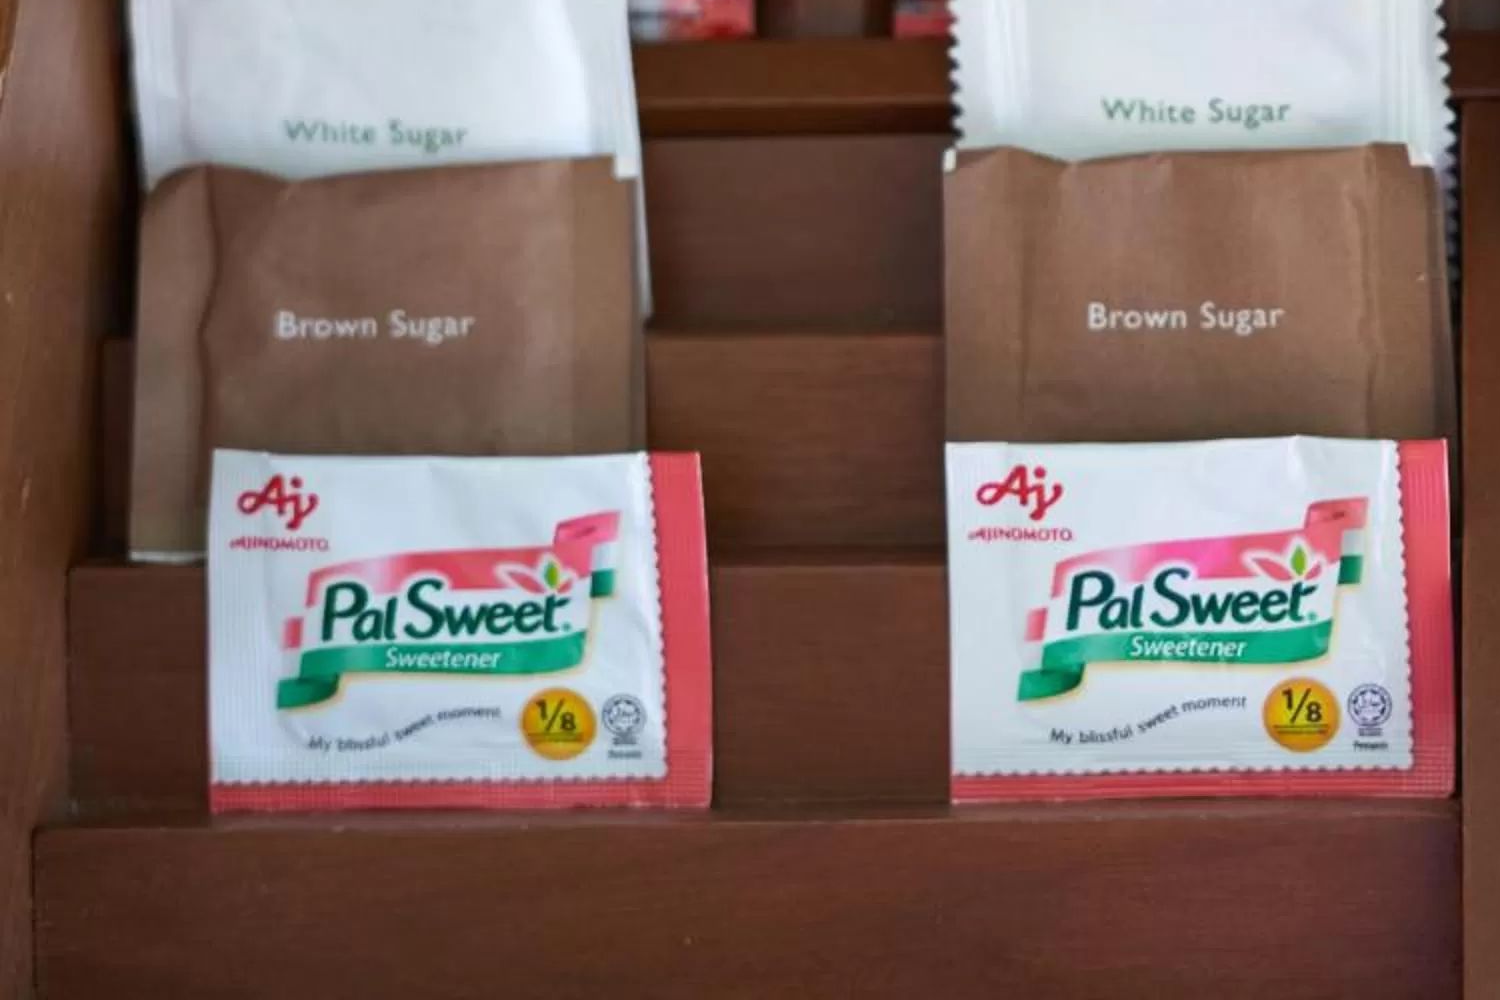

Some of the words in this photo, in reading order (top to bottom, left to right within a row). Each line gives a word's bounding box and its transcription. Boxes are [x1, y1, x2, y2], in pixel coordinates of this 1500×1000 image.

[1101, 97, 1196, 124] White
[1209, 99, 1291, 132] Sugar
[283, 119, 375, 145] White
[389, 119, 468, 153] Sugar
[274, 311, 377, 339] Brown
[390, 309, 475, 345] Sugar
[1087, 303, 1187, 331] Brown
[1201, 302, 1284, 335] Sugar
[385, 646, 502, 670] Sweetener
[1130, 634, 1247, 659] Sweetener
[536, 697, 577, 732] 1/8
[1050, 727, 1073, 745] My
[1078, 723, 1134, 744] blissful
[1137, 703, 1179, 733] sweet
[1181, 695, 1247, 713] moment
[1281, 687, 1323, 725] 1/8
[308, 735, 331, 752] My
[394, 713, 435, 741] sweet
[437, 705, 501, 721] moment
